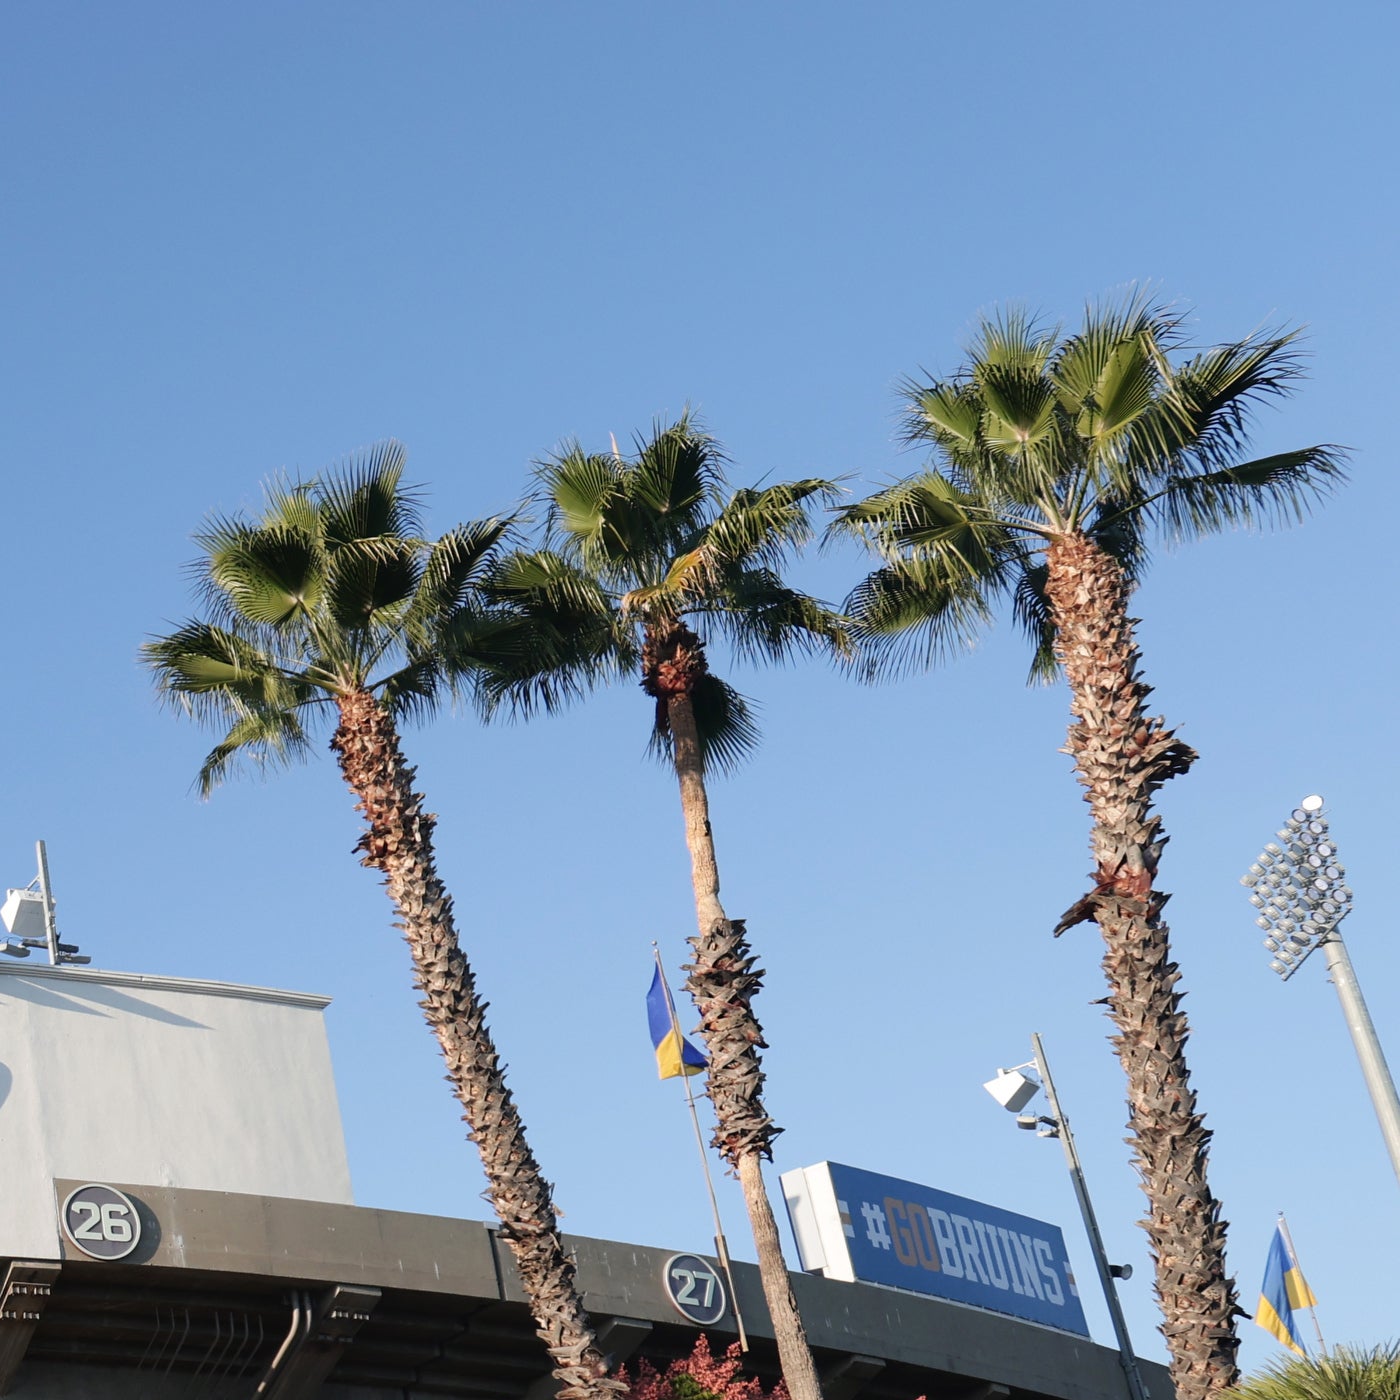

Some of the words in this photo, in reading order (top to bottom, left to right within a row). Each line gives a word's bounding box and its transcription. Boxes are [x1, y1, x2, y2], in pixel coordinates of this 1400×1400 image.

[71, 1201, 132, 1242] 26
[860, 1196, 1066, 1307] #GOBRUINS
[671, 1267, 715, 1308] 27
